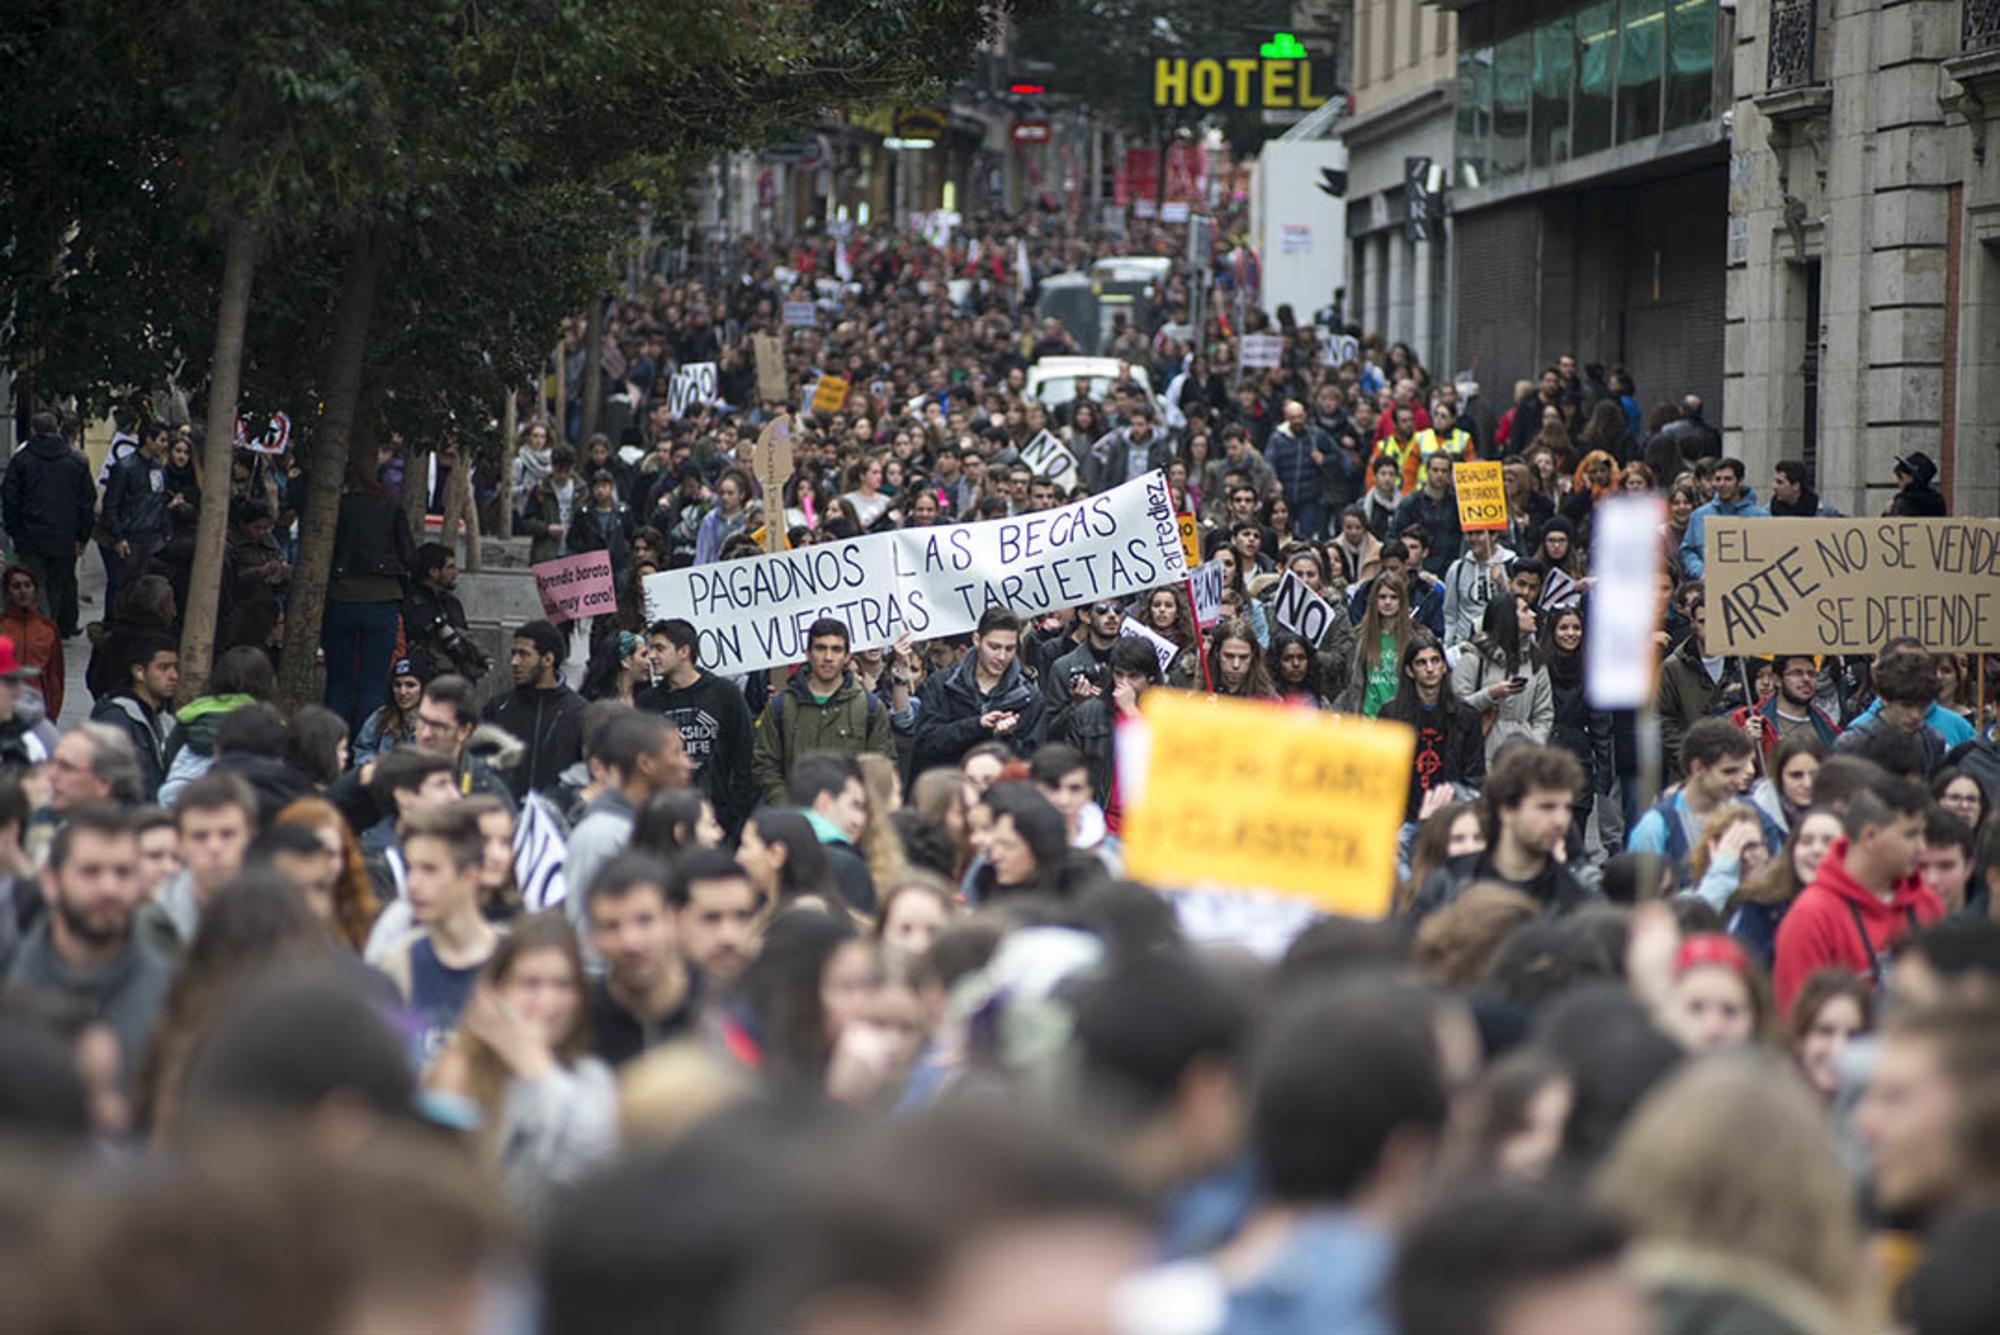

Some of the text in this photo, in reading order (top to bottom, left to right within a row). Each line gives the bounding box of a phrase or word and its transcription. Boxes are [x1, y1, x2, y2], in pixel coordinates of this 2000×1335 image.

[1154, 58, 1328, 107] HOTEL
[1026, 435, 1071, 478] NO
[688, 544, 865, 616] PAGADNOS
[893, 529, 972, 578] LAS
[1000, 496, 1117, 565] BECAS
[1716, 529, 1765, 563] EL
[1815, 528, 1868, 578] NO
[1878, 523, 1918, 568] SE
[576, 564, 609, 582] barato
[1721, 546, 1821, 646] ARTE
[699, 624, 743, 669] ON
[752, 590, 929, 659] VUETRAS
[954, 539, 1156, 621] TARJETAS
[1276, 573, 1327, 645] NO
[1817, 597, 1860, 646] SE
